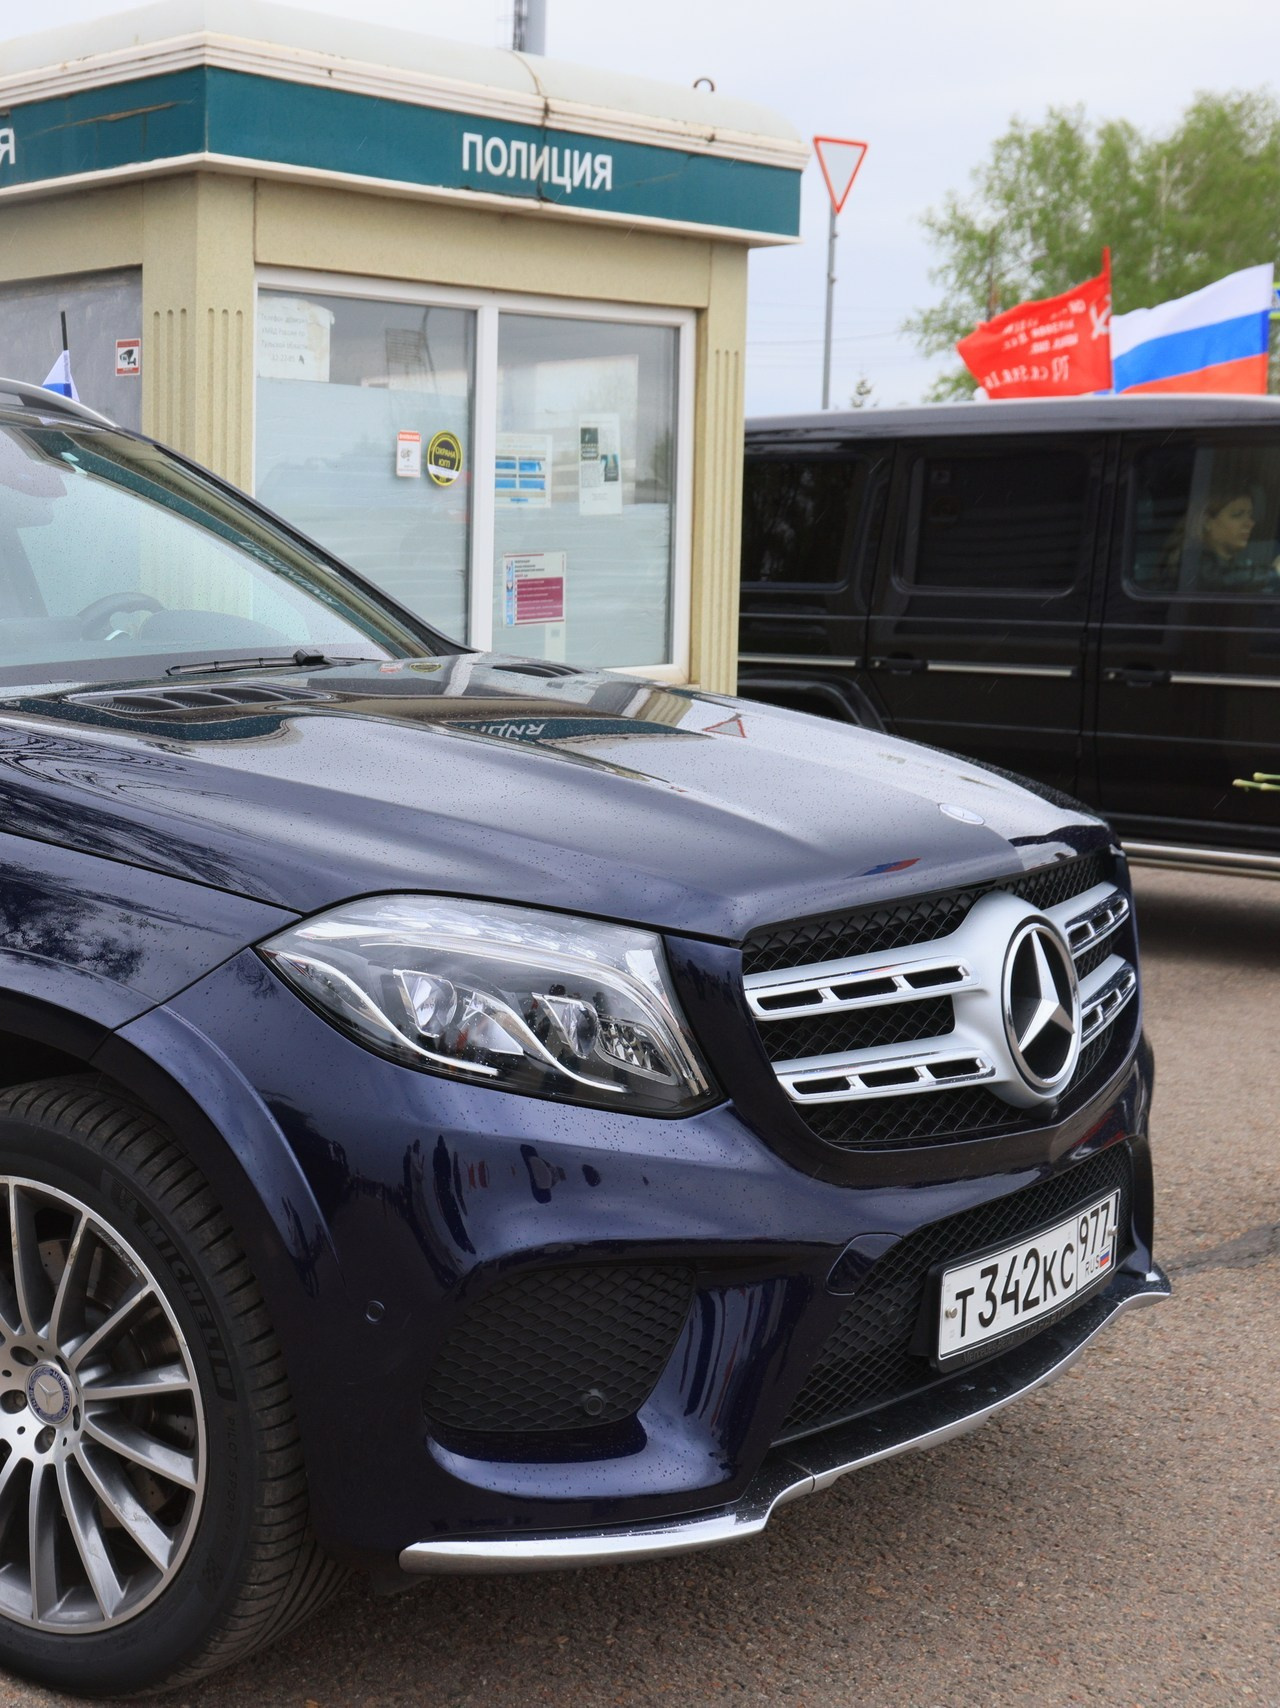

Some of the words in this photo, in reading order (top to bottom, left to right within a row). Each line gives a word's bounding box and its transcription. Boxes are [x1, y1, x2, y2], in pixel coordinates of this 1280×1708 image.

[462, 131, 613, 195] ПОЛИЦИЯ
[1080, 1201, 1111, 1263] 977
[1085, 1253, 1100, 1278] RUS
[139, 1216, 235, 1391] MICHELIN
[224, 1416, 239, 1463] PILOT
[223, 1469, 239, 1524] SPORT
